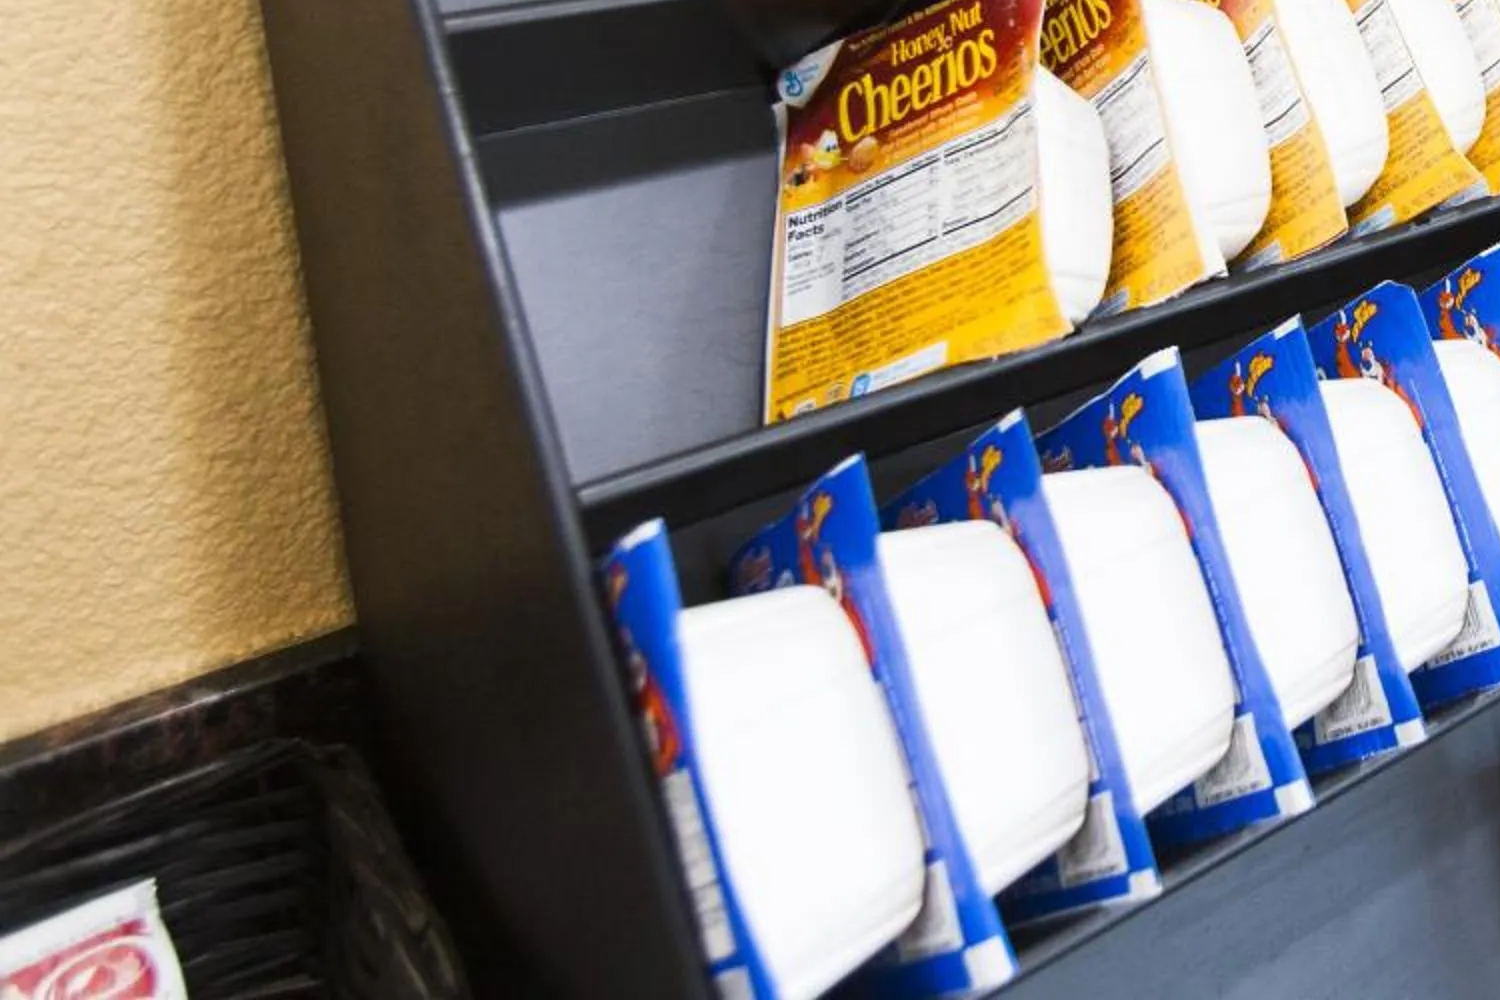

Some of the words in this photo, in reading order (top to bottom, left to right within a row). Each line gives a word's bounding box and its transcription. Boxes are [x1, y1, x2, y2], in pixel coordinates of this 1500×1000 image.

[890, 23, 947, 67] Honey
[949, 0, 984, 37] Nut
[837, 28, 998, 143] Cheerios
[788, 200, 843, 229] Nutrition
[788, 223, 826, 242] Facts
